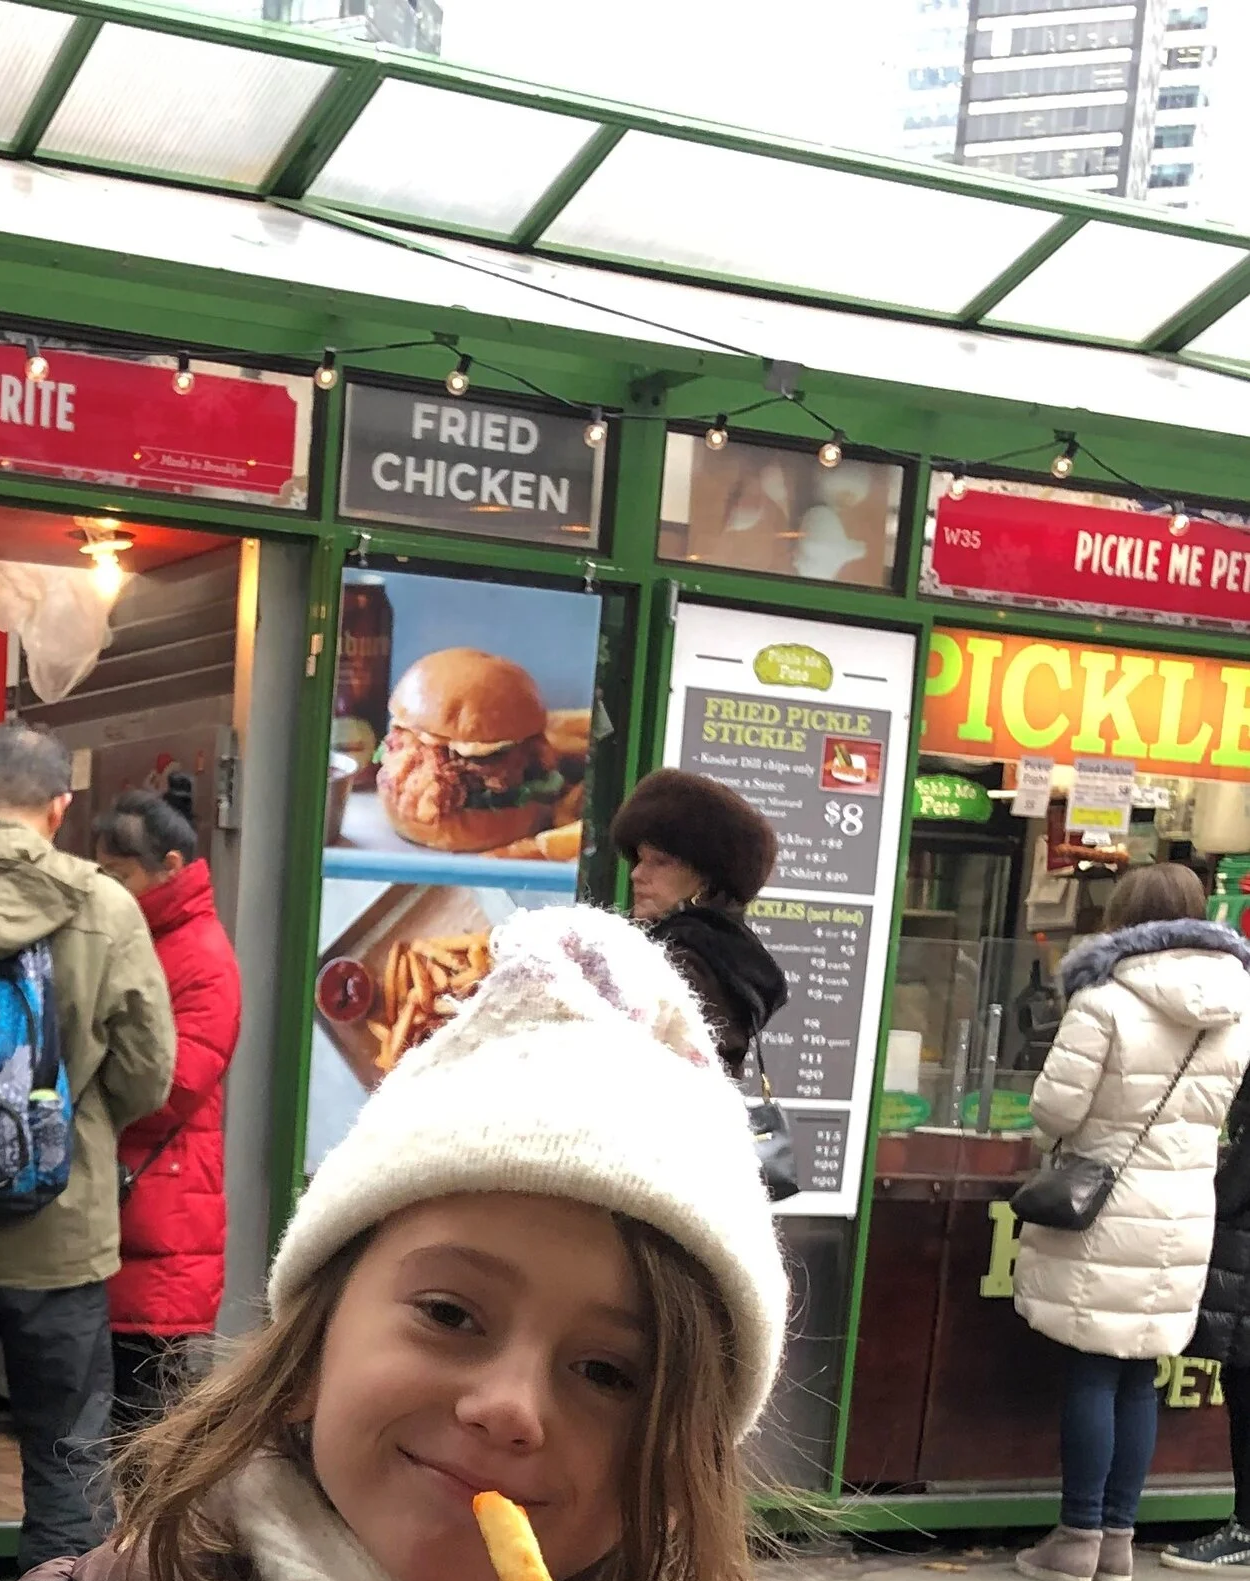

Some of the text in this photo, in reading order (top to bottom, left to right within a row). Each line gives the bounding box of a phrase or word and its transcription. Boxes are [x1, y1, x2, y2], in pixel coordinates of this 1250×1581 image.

[411, 402, 539, 455] FRIED
[371, 452, 570, 514] CHICKEN
[943, 526, 981, 549] W35
[1074, 530, 1162, 582] PICKLE
[1167, 542, 1205, 587] ME
[704, 697, 872, 737] FRIED PICKLE
[702, 719, 807, 753] STICKLE
[920, 796, 960, 816] Pete
[955, 783, 976, 799] Me
[824, 800, 863, 836] $8
[779, 866, 822, 880] T-Shirt
